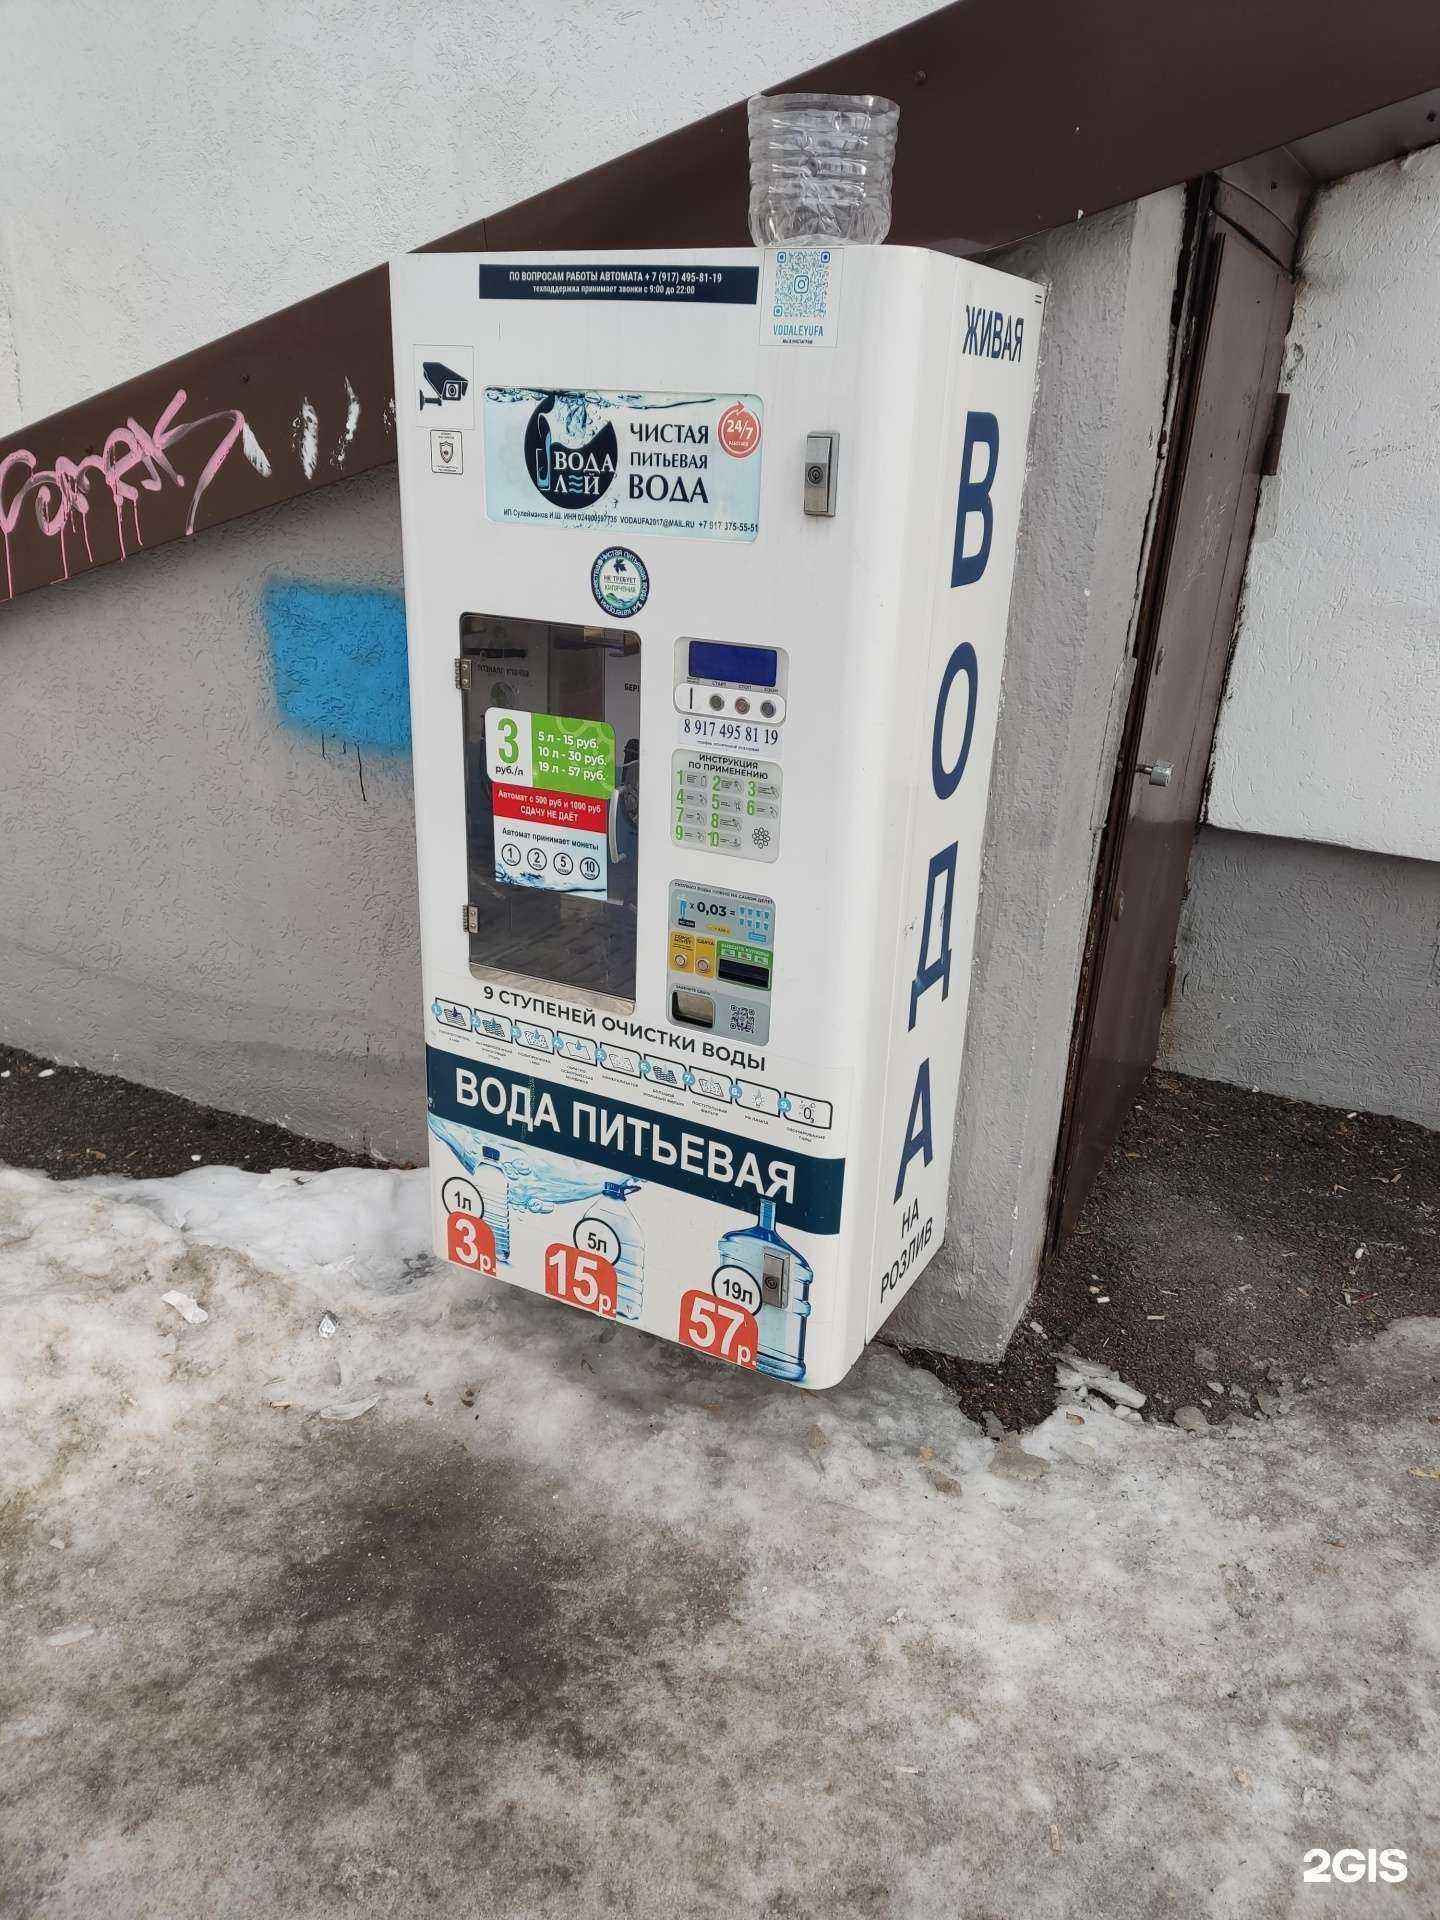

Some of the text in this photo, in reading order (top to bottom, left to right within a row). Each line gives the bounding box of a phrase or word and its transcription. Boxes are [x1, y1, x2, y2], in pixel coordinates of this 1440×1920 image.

[509, 271, 520, 281] ПО
[521, 271, 564, 281] ВОПРОСАМ
[566, 271, 598, 281] РАБОТЫ
[600, 271, 643, 282] АВТОМАТА
[652, 272, 657, 282] 7
[658, 271, 679, 284] (917)
[681, 272, 722, 284] 495-81-19
[532, 285, 580, 295] техподдержка
[581, 285, 617, 295] принимает
[618, 286, 643, 294] звонки
[649, 285, 664, 294] 9:00
[665, 287, 675, 295] до
[676, 286, 695, 295] 22:00
[773, 324, 824, 337] VODALEYUFA
[962, 305, 1024, 362] ЖИВАЯ
[630, 423, 709, 444] ЧИСТАЯ
[726, 419, 753, 440] 24/7
[554, 451, 615, 472] ВОДА
[630, 452, 708, 469] ПИТЬЕВАЯ
[629, 474, 709, 503] ВОДА
[503, 508, 512, 517] ИП
[563, 512, 577, 521] ИНН
[620, 516, 695, 529] VODAUFA2017@MAIL.RU
[698, 520, 707, 529] +7
[538, 731, 545, 742] 5
[546, 734, 555, 743] л
[563, 734, 574, 745] 15
[576, 738, 600, 750] руб.
[684, 718, 779, 745] 8 917 495 81 19
[497, 717, 520, 765] 3
[538, 746, 549, 757] 10
[552, 749, 559, 759] л
[568, 750, 581, 761] 30
[584, 754, 607, 766] руб.
[699, 753, 759, 769] ИНСТРУКЦИЯ
[495, 765, 524, 777] руб./л
[539, 762, 549, 772] 19
[552, 765, 560, 774] л
[568, 766, 581, 777] 57
[583, 770, 606, 781] руб.
[676, 769, 683, 785] 1
[688, 761, 769, 780] ПО ПРИМЕНЕНИЮ
[712, 774, 720, 791] 2
[748, 780, 756, 797] 3
[498, 789, 528, 801] Автомат
[535, 795, 548, 804] 500
[548, 799, 562, 808] руб
[570, 801, 587, 811] 1000
[588, 804, 601, 814] руб
[676, 788, 684, 804] 4
[711, 793, 720, 809] 5
[520, 805, 545, 817] СДАЧУ
[546, 809, 557, 819] НЕ
[675, 806, 684, 822] 7
[746, 799, 755, 815] 6
[894, 411, 999, 1205] ВОДА
[711, 812, 719, 828] 8
[502, 827, 599, 851] Автомат принимает монеты
[675, 824, 684, 840] 9
[707, 831, 720, 847] 10
[507, 847, 513, 859] 1
[534, 851, 541, 864] 2
[560, 856, 567, 868] 5
[585, 860, 595, 874] 10
[697, 901, 727, 917] 0,03
[484, 985, 765, 1072] 9 СТУПЕНЕЙ ОЧИСТКИ ВОДЫ
[455, 1067, 796, 1204] ВОДА ПИТЬЕВАЯ
[454, 1191, 472, 1212] 1л
[901, 1198, 920, 1238] НА
[587, 1232, 607, 1254] 5л
[881, 1217, 933, 1304] РОЗЛИВ
[722, 1278, 753, 1305] 19л
